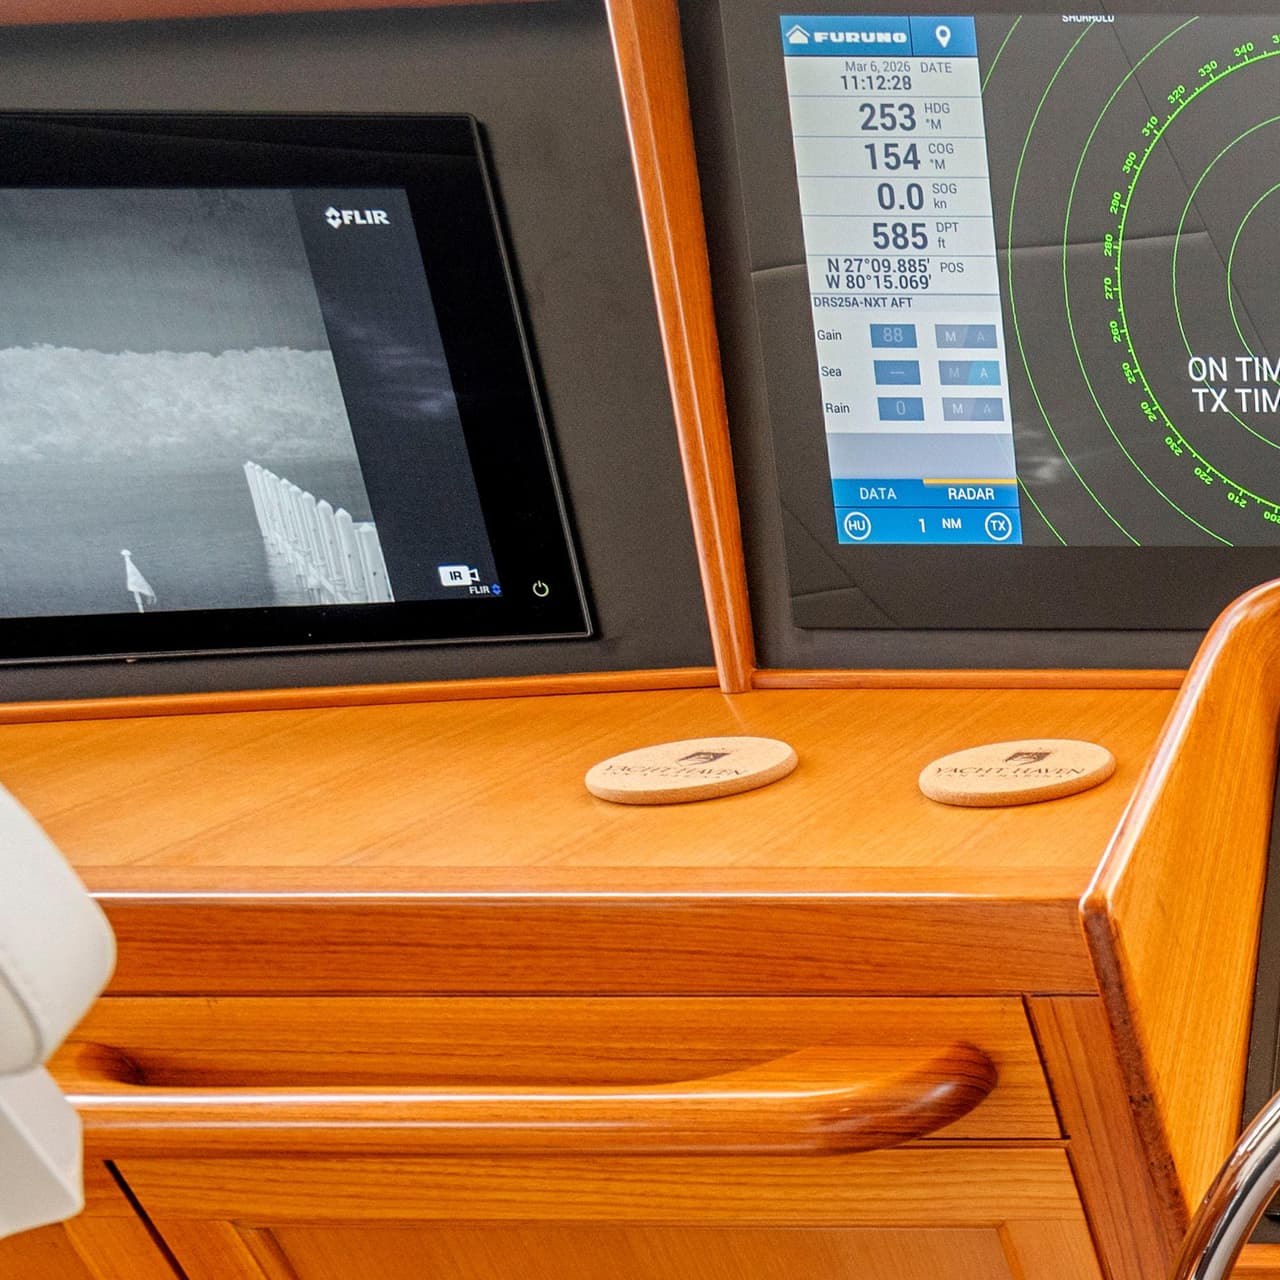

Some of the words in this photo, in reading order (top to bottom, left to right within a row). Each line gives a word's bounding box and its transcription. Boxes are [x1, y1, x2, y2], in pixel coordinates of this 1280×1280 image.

[814, 32, 907, 43] FURUNO
[1233, 42, 1255, 57] 340
[845, 61, 867, 72] Mar
[870, 61, 880, 75] 6,
[882, 61, 911, 72] 2026
[920, 62, 952, 73] DATE
[1198, 60, 1218, 77] 330
[841, 76, 912, 90] 11:12:28
[1167, 85, 1186, 104] 320
[859, 104, 916, 131] 253
[925, 104, 950, 114] HDG
[1141, 116, 1159, 138] 310
[864, 143, 920, 170] 154
[928, 144, 954, 154] COG
[877, 183, 924, 210] 0.0
[932, 184, 957, 194] SOG
[934, 199, 947, 209] kn
[342, 210, 390, 225] FLIR
[873, 223, 928, 250] 585
[936, 222, 959, 233] DPT
[938, 238, 946, 249] ft
[828, 259, 840, 272] N
[940, 263, 964, 273] POS
[826, 275, 840, 289] W
[814, 298, 888, 308] DRS25A-NXT
[891, 298, 913, 308] AFT
[817, 330, 842, 341] Gain
[883, 328, 904, 342] 88
[946, 332, 956, 342] M
[822, 367, 842, 377] Sea
[980, 368, 988, 378] A
[1188, 357, 1227, 382] ON
[1192, 389, 1229, 413] TX
[826, 403, 850, 413] Rain
[952, 404, 963, 414] M
[860, 488, 897, 500] DATA
[948, 488, 995, 500] RADAR
[849, 520, 866, 531] HU
[918, 518, 926, 533] 1
[942, 518, 962, 529] NM
[990, 520, 1007, 531] TX
[450, 571, 463, 580] IR
[469, 586, 490, 594] FLIR
